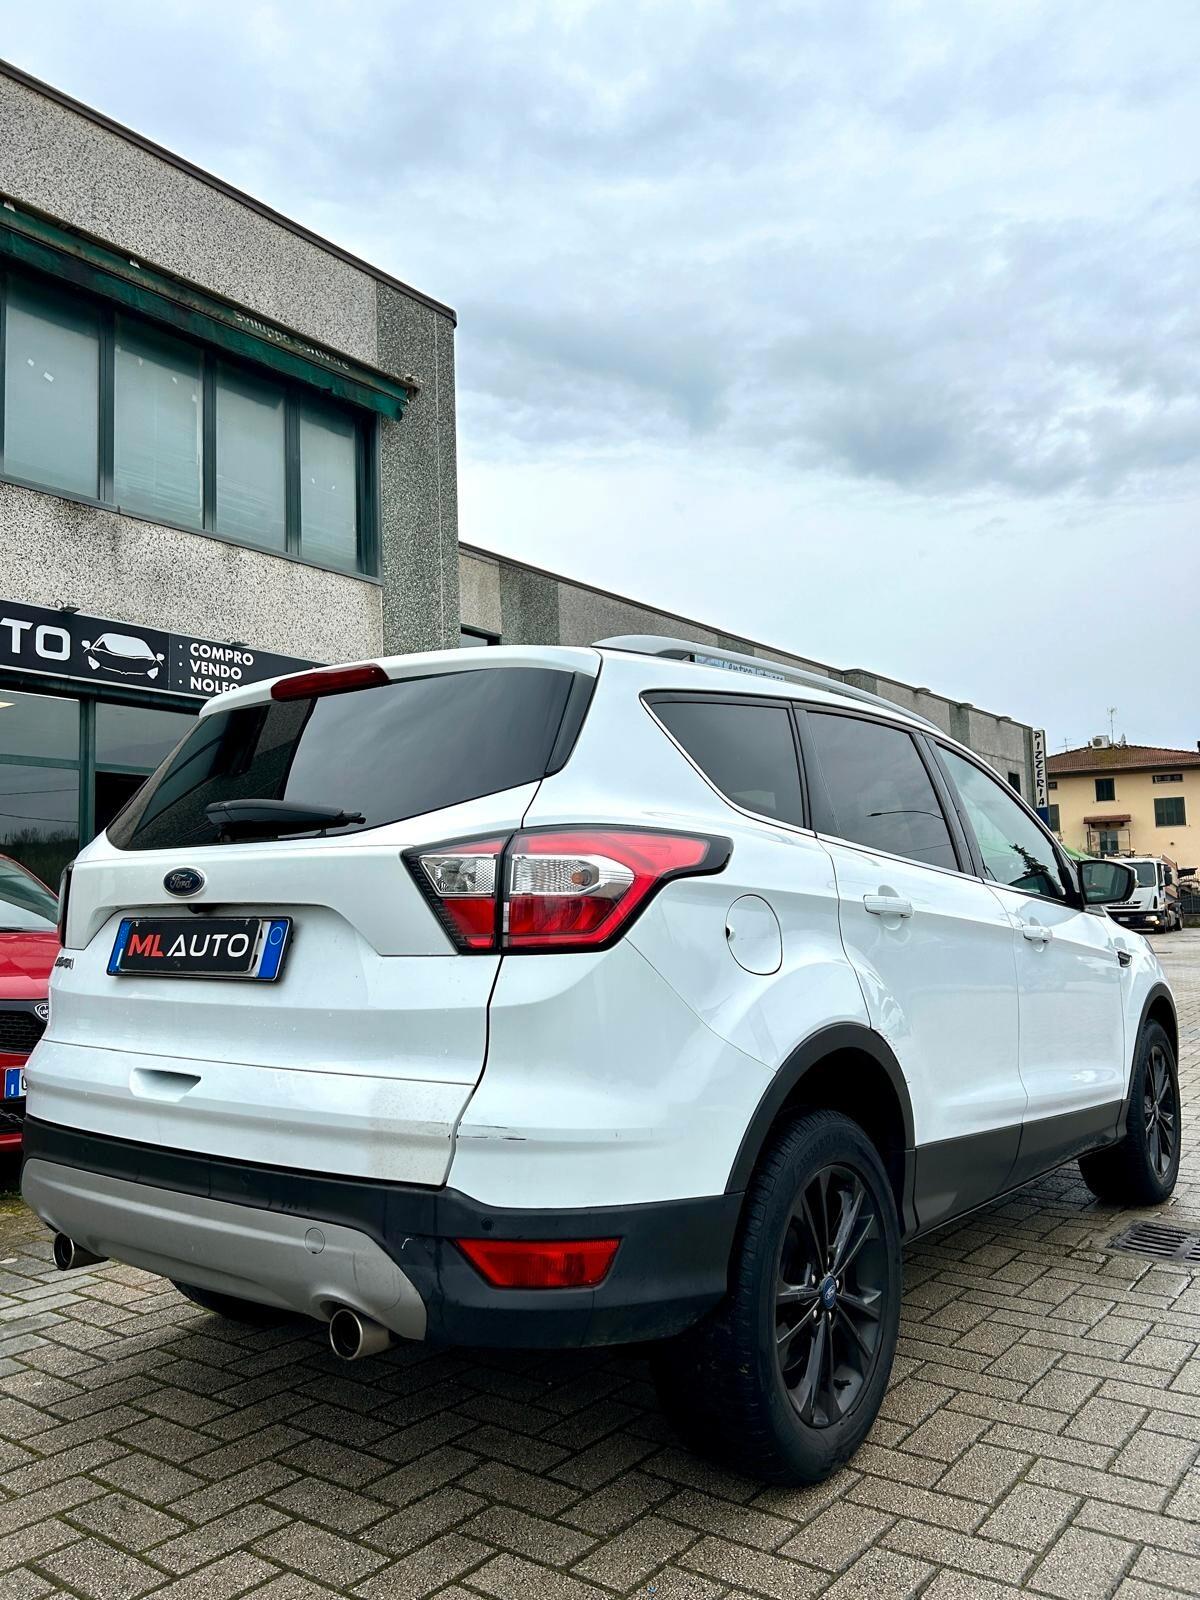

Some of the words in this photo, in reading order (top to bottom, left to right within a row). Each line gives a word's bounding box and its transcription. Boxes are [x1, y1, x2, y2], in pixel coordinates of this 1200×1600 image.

[190, 642, 254, 666] COMPRO
[190, 660, 242, 680] VENDO
[1034, 732, 1045, 806] PIZZERIA
[169, 873, 193, 889] Ford
[127, 934, 164, 957] ML
[166, 933, 250, 958] AUTO
